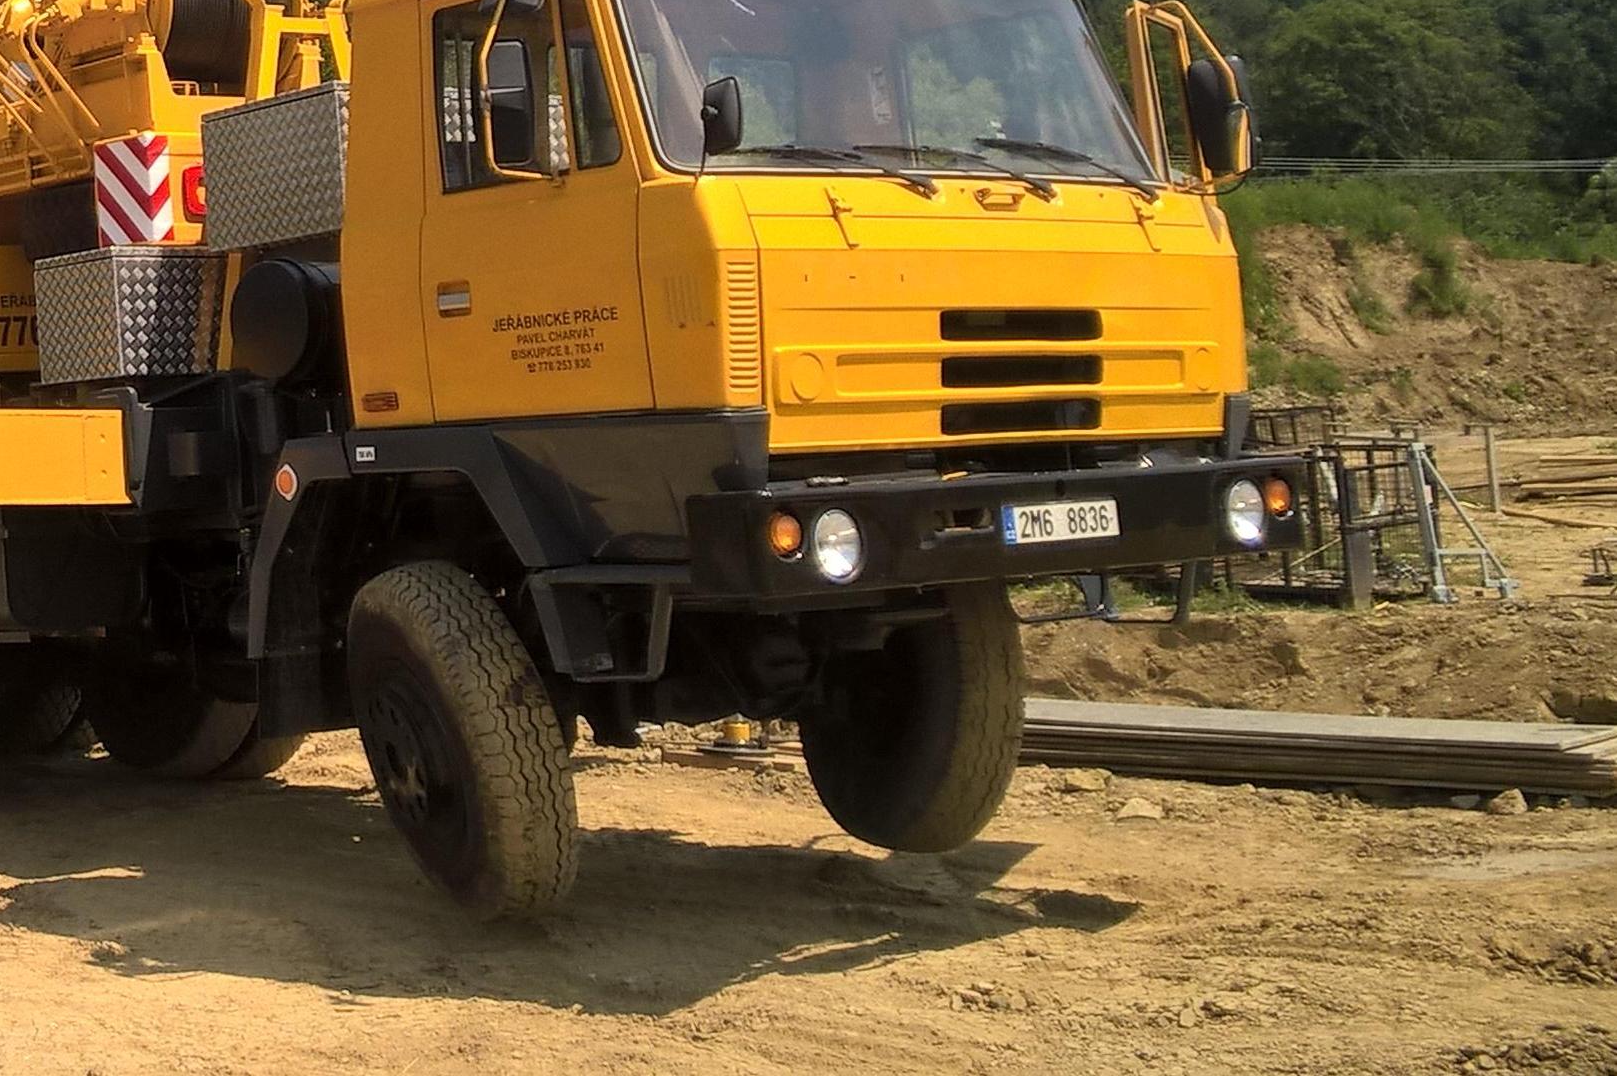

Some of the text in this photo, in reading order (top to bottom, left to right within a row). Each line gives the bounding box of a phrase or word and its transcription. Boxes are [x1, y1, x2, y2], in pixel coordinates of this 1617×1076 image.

[492, 306, 619, 332] JEŘÁBNICKÉ PRÁCE
[517, 326, 595, 345] PAVEL CHARVÁT
[511, 345, 563, 360] BISKUPICE
[1019, 505, 1110, 538] 2M6 8836
